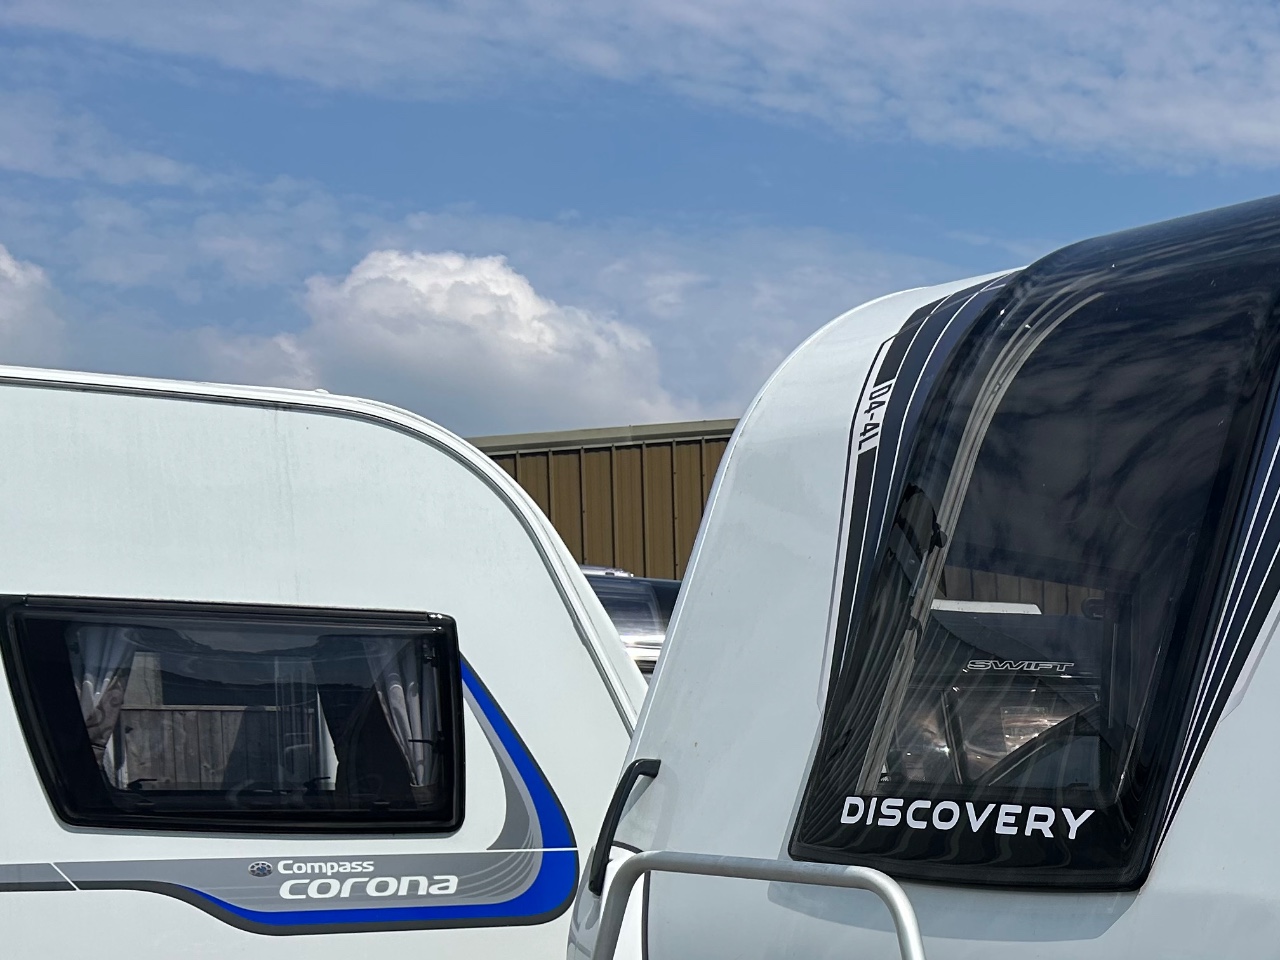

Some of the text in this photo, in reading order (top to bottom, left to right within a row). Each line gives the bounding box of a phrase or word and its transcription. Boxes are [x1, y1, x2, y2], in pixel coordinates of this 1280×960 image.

[858, 383, 893, 451] D4-4L
[967, 660, 1075, 672] SWIFT
[840, 796, 1096, 840] DISCOVERY
[277, 860, 375, 875] Compass
[279, 875, 459, 899] corona
